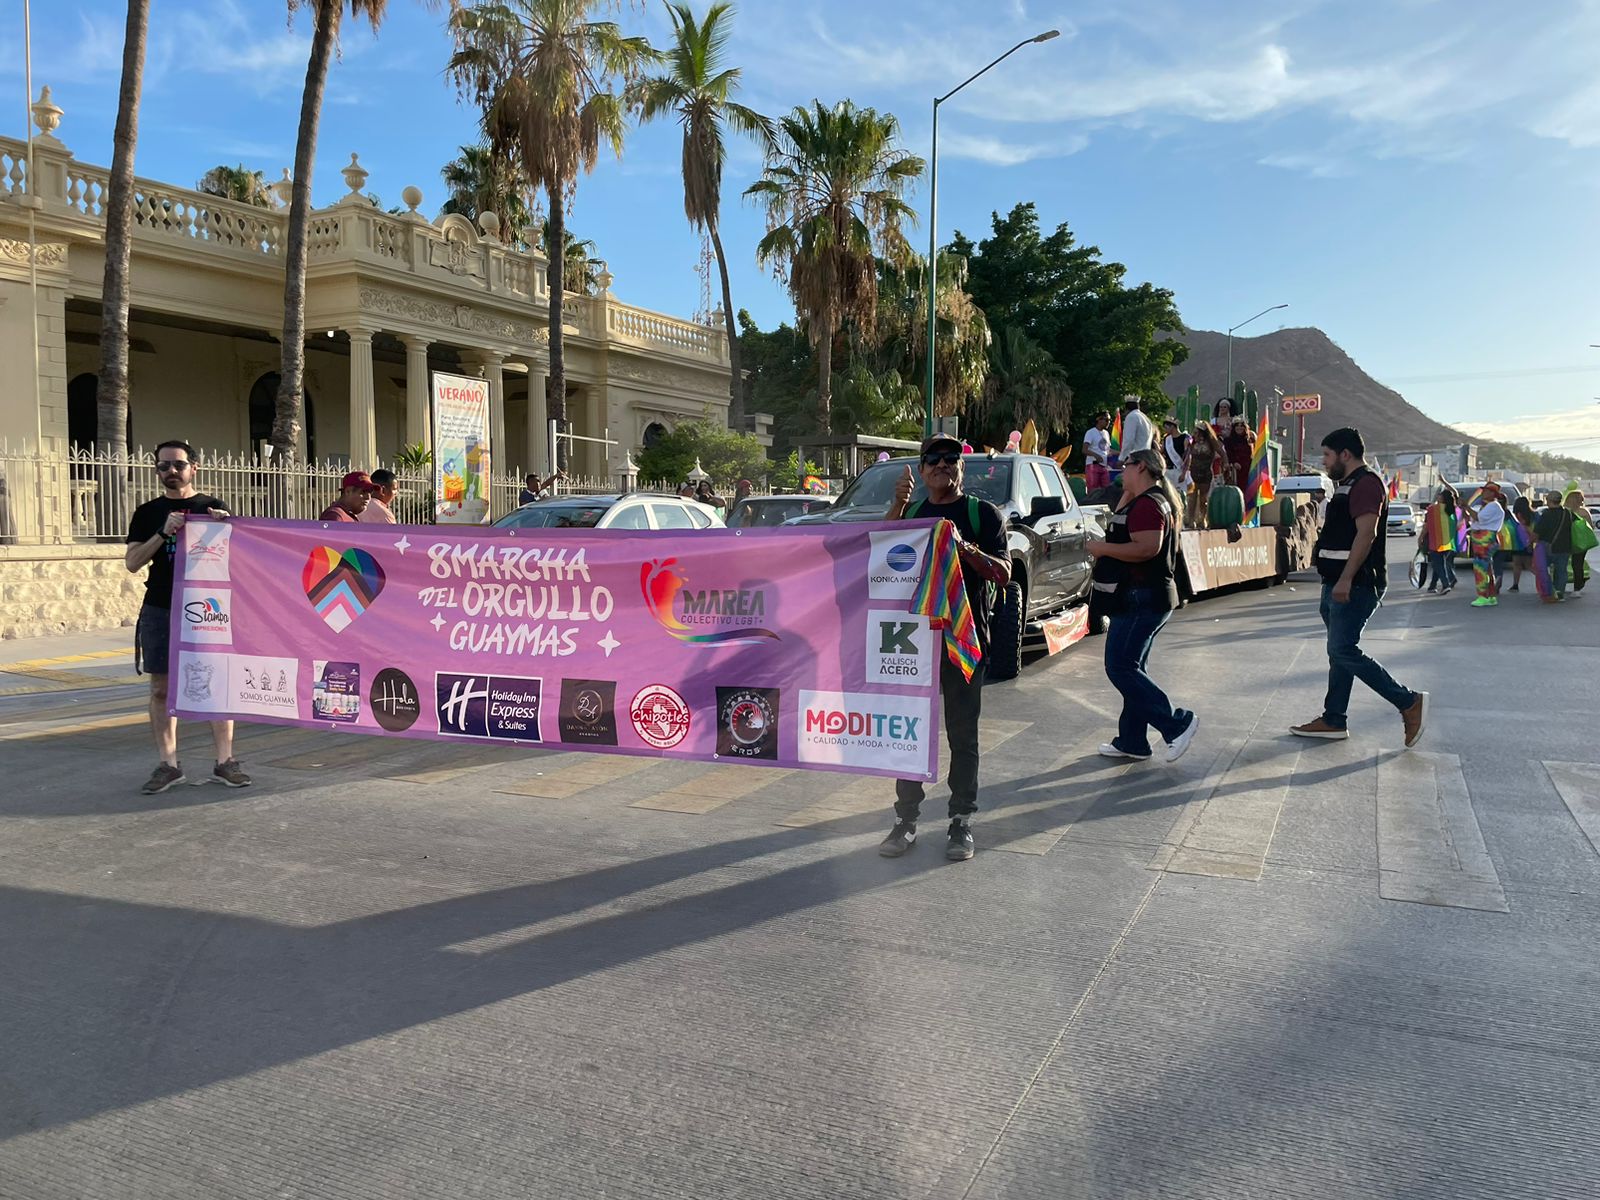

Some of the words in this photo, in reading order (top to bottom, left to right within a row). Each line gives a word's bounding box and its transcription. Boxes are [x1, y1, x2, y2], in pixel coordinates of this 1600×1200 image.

[439, 387, 483, 403] VERANO
[1282, 398, 1318, 411] OXXO
[870, 576, 899, 584] KONICA
[418, 586, 458, 609] DEL
[462, 581, 614, 622] ORGULLO
[683, 590, 765, 616] MAREA
[184, 601, 229, 625] Stampa
[680, 615, 732, 625] COLECTIVO
[450, 621, 579, 657] GUAYMAS
[879, 621, 919, 655] K
[881, 657, 917, 666] KALISCH
[879, 665, 919, 676] ACERO
[240, 692, 263, 701] SOMOS
[264, 694, 295, 705] GUAYMAS
[374, 679, 416, 716] Hola
[491, 689, 522, 704] Holiday
[523, 694, 537, 703] Inn
[490, 703, 536, 720] Express
[632, 709, 689, 725] Chipotles
[498, 720, 503, 729] &
[504, 721, 527, 731] Suites
[806, 709, 918, 741] MODITEX
[813, 736, 849, 746] CALIDAD
[858, 740, 884, 749] MODA
[892, 742, 918, 752] COLOR
